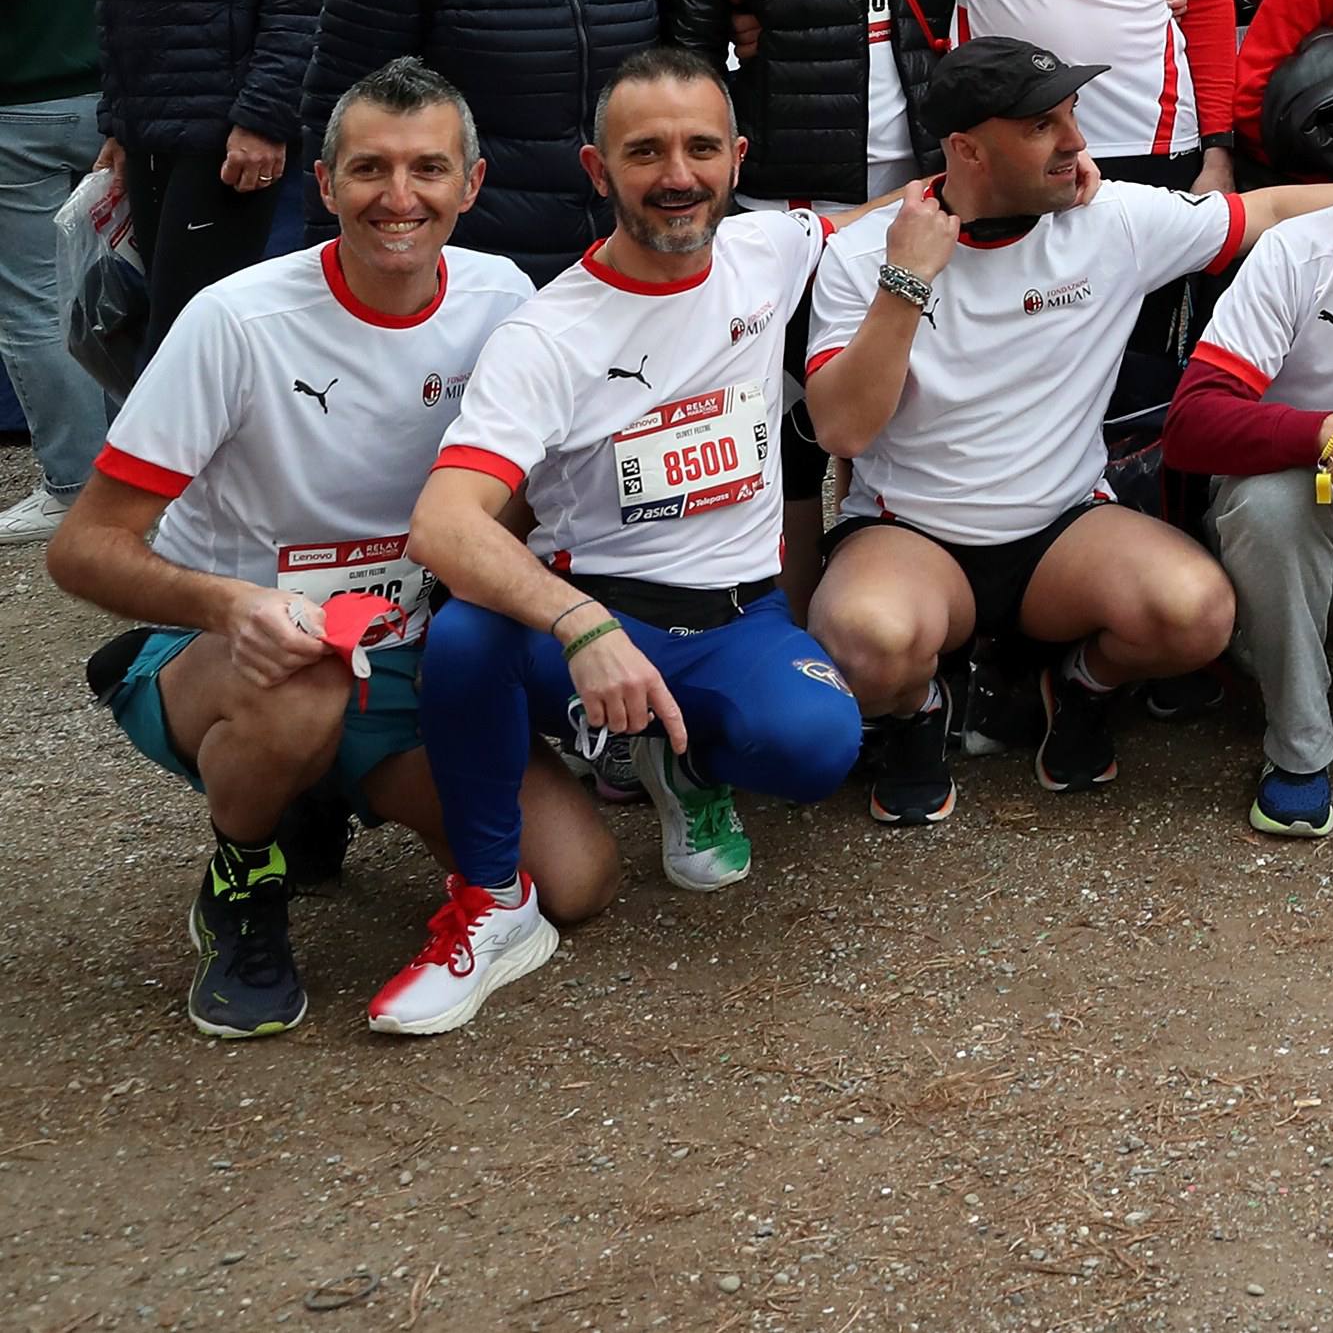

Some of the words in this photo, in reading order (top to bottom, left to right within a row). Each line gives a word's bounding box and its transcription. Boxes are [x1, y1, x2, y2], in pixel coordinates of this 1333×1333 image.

[1047, 284, 1092, 308] MILAN
[686, 397, 717, 412] RELAY
[663, 436, 739, 487] 850D
[696, 492, 729, 507] Telepass
[644, 503, 678, 519] asics
[366, 542, 399, 553] RELAY
[293, 551, 333, 562] Lenovo
